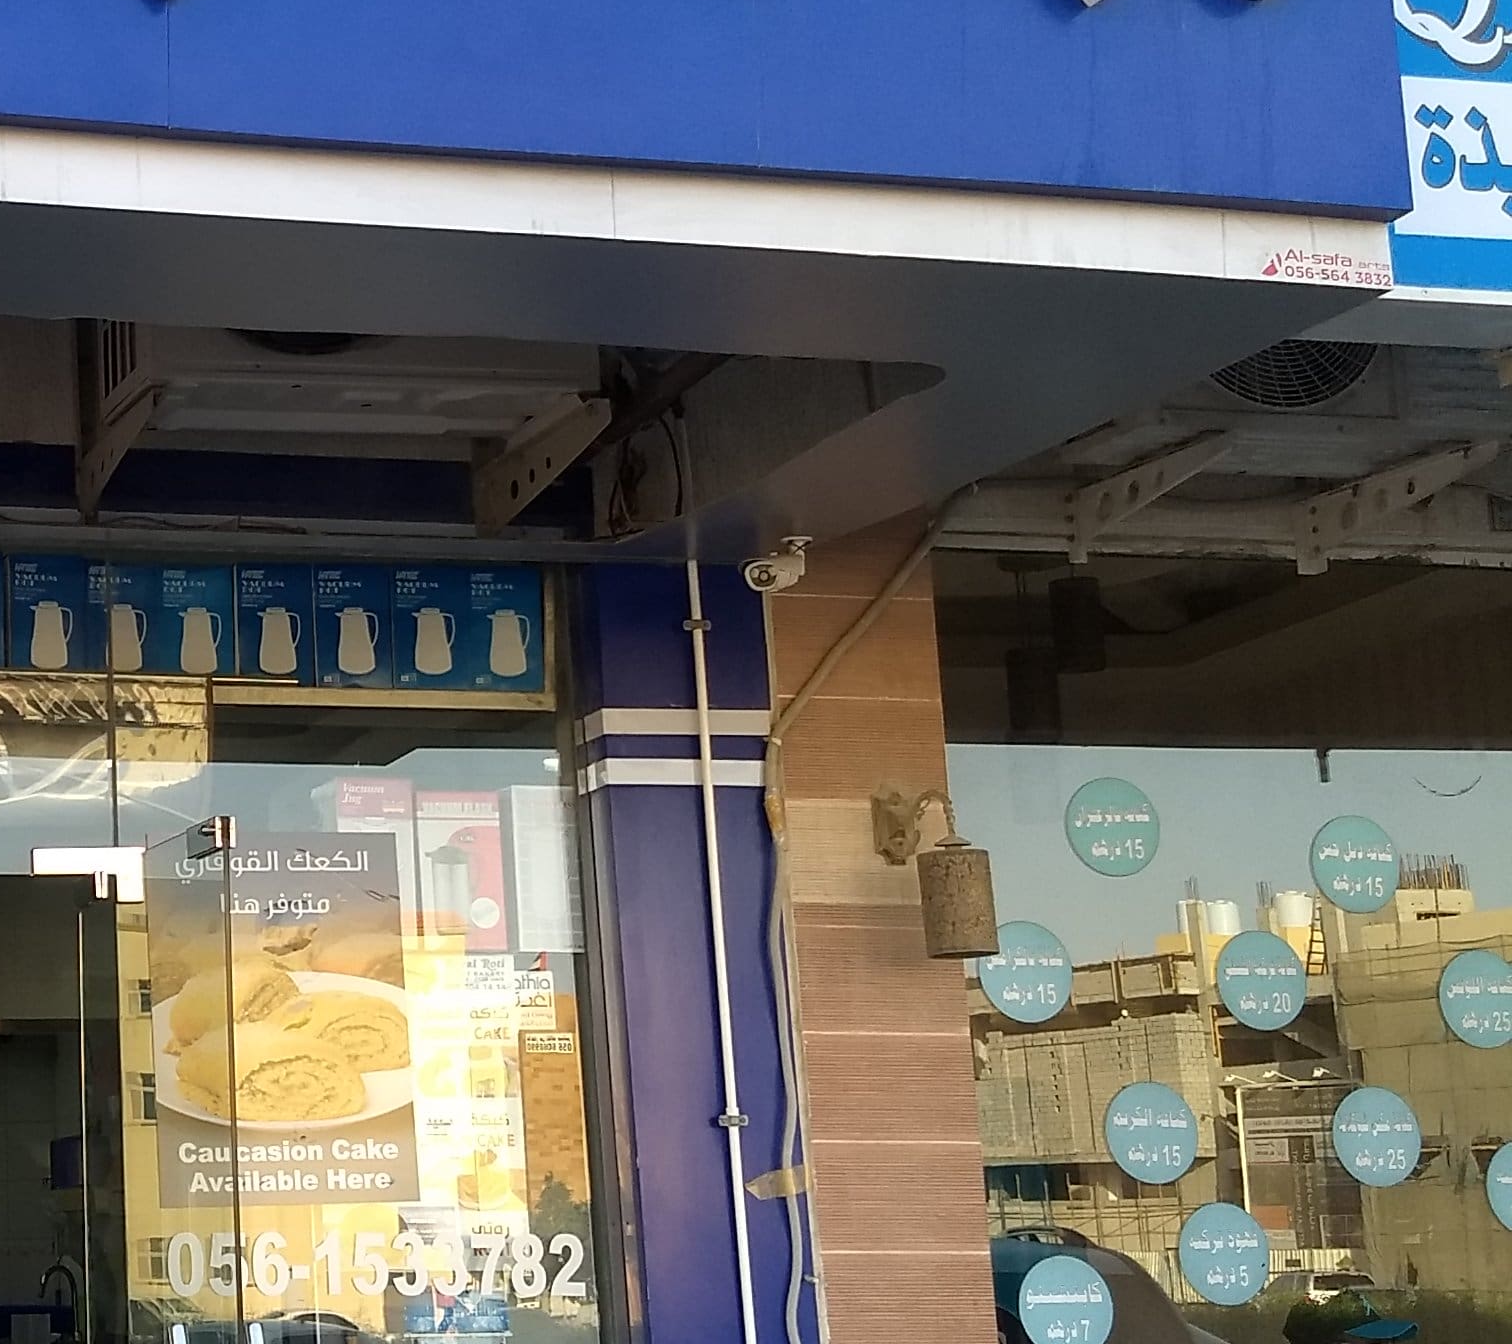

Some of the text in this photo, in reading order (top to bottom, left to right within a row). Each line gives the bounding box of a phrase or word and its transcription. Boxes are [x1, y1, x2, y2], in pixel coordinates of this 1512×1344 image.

[1285, 248, 1352, 267] Al-safa
[1285, 265, 1392, 287] 056-564 3832
[286, 849, 369, 872] الكعك
[265, 893, 330, 920] متوفر
[179, 1138, 399, 1163] Caucasion Cake
[1162, 1144, 1181, 1166] 15
[1387, 1148, 1406, 1170] 25
[189, 1168, 392, 1193] Available Here
[167, 1231, 587, 1298] 056-1533782
[1239, 1265, 1249, 1287] 5
[1080, 1319, 1090, 1341] 7
